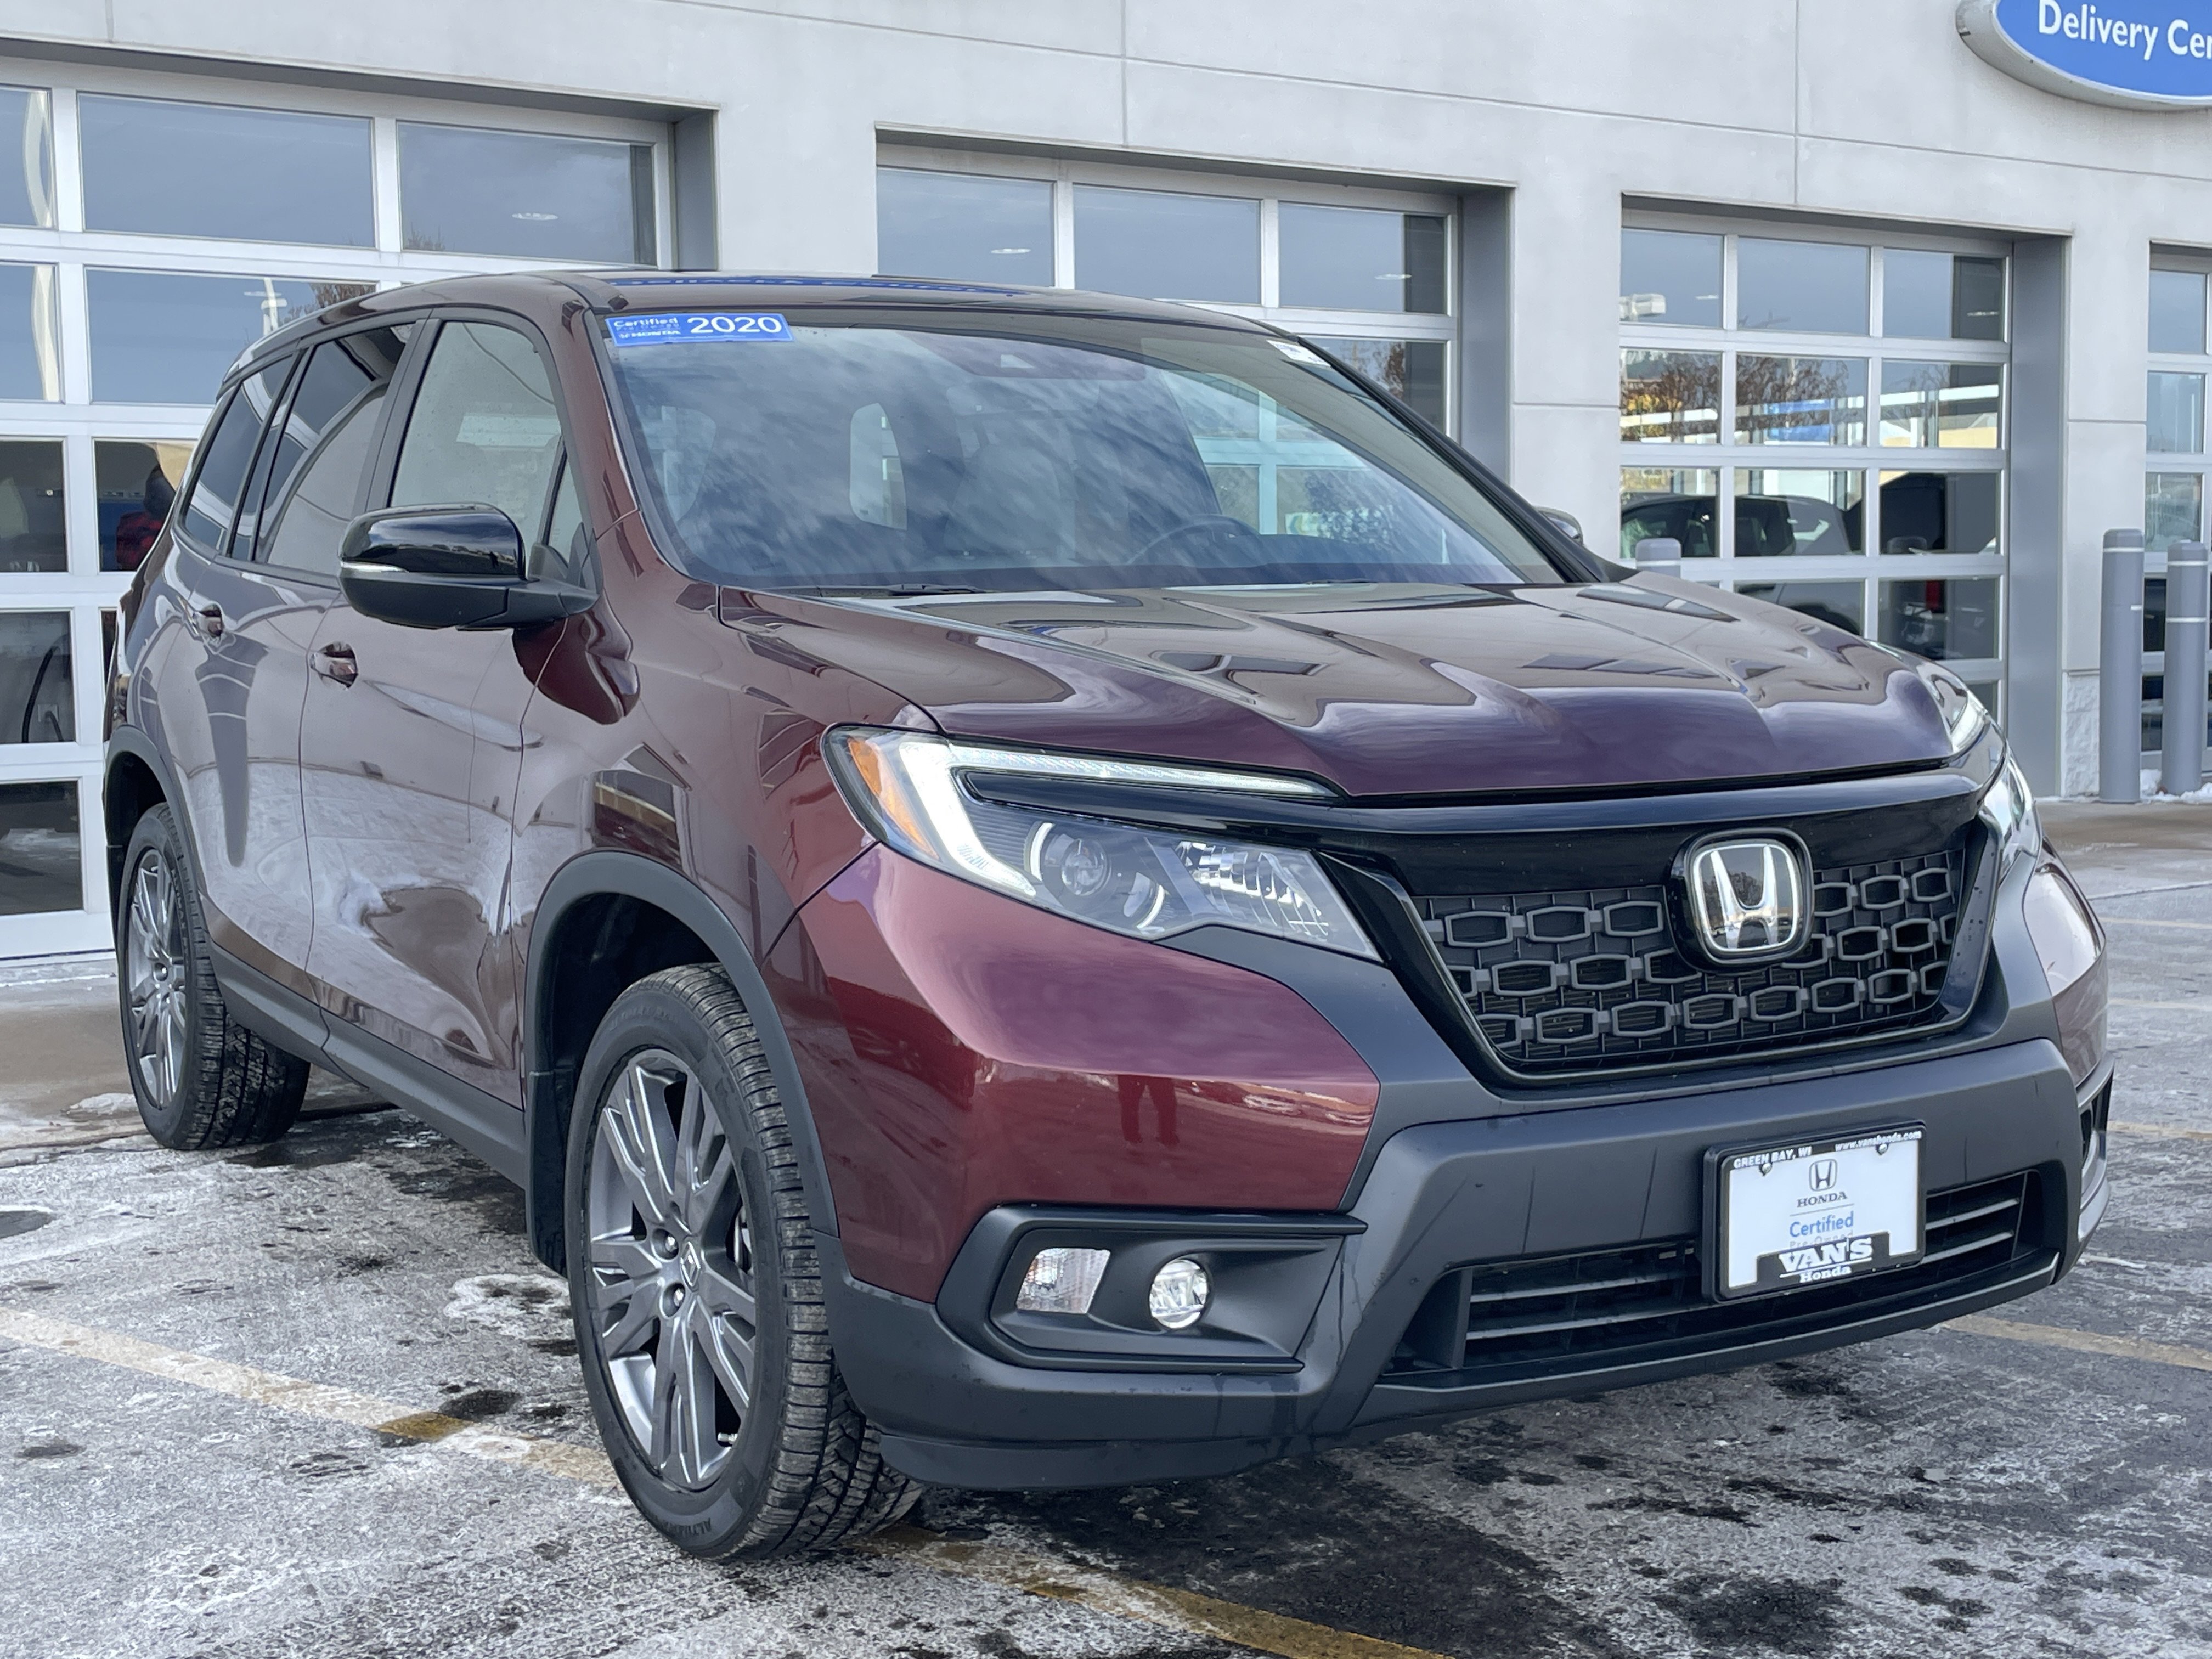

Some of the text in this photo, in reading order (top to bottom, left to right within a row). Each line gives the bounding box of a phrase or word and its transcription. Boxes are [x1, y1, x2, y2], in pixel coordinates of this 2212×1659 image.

[2039, 0, 2158, 60] Delivery
[614, 317, 678, 327] Certified
[687, 317, 782, 334] 2020
[1734, 1146, 1812, 1169] GREEN BAY, WI
[1797, 1191, 1848, 1208] HONDA
[1790, 1210, 1854, 1238] Certified
[1799, 1265, 1852, 1284] Honda
